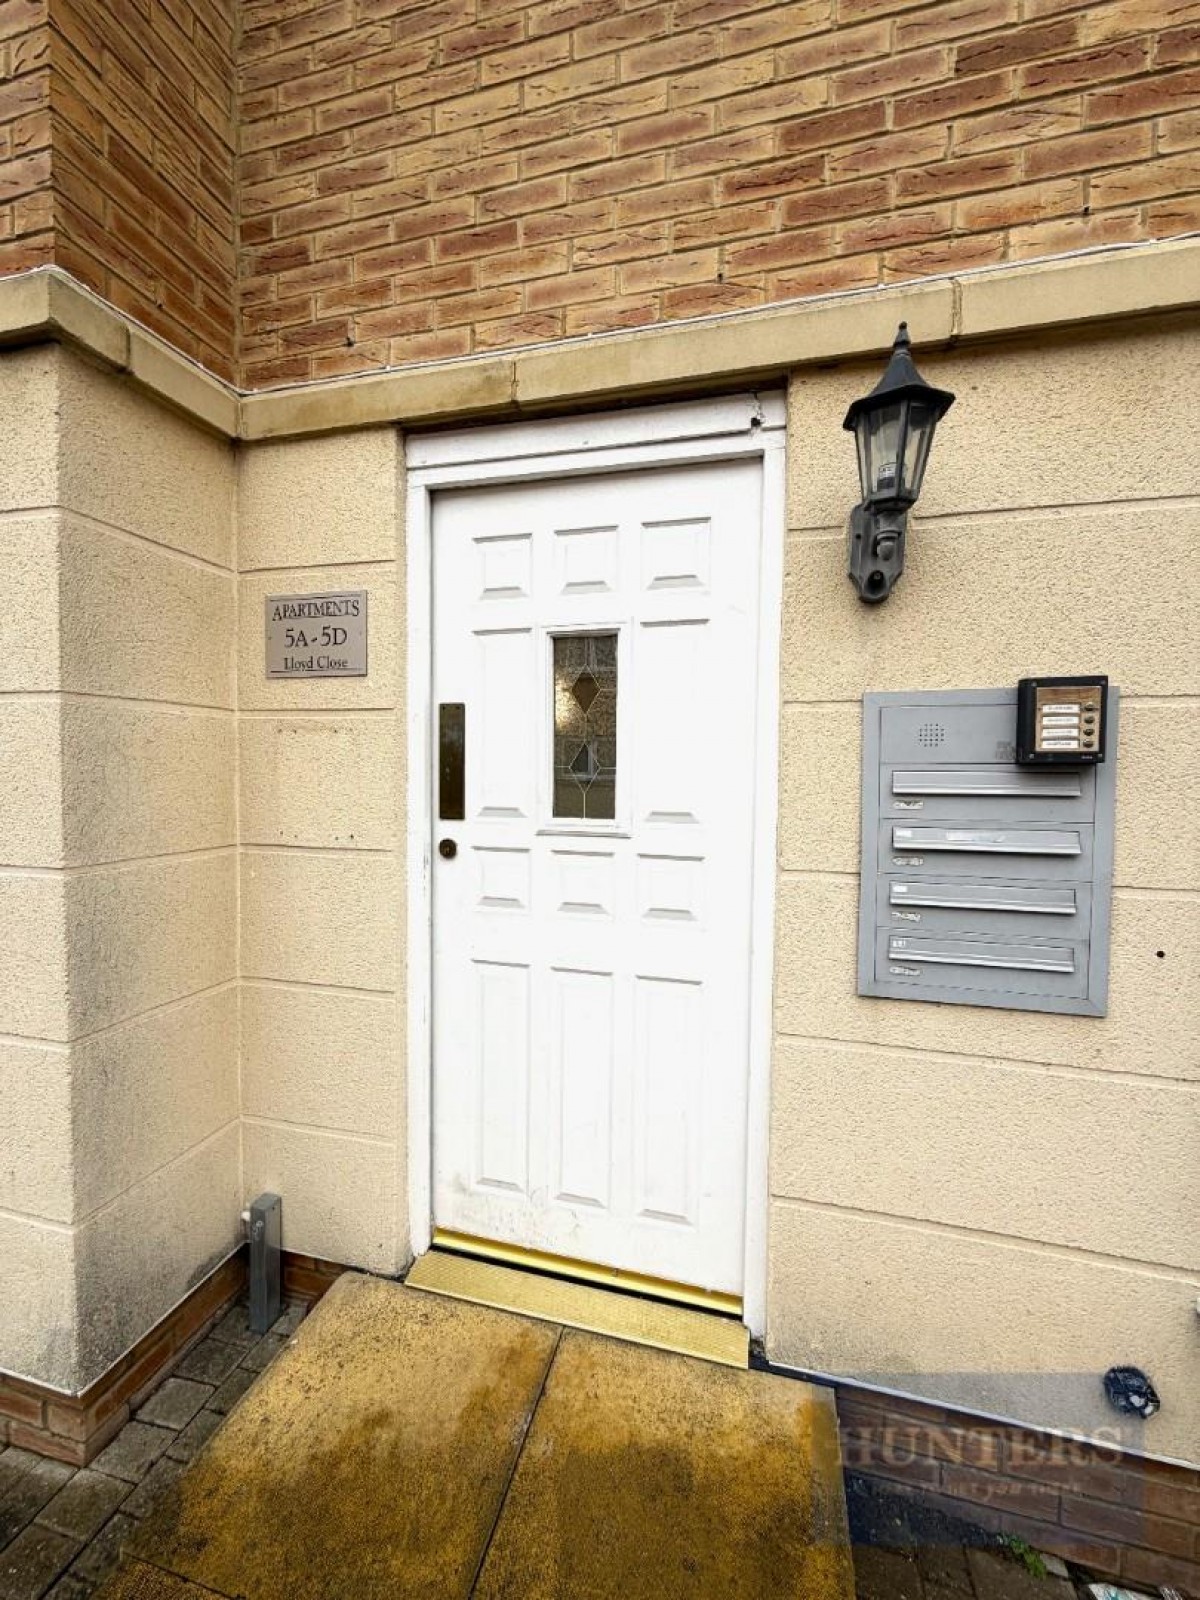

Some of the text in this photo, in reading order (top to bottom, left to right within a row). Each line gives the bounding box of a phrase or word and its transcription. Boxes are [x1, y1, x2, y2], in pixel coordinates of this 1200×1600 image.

[272, 600, 360, 621] APARTMENTS
[283, 656, 349, 671] Lloyd Close
